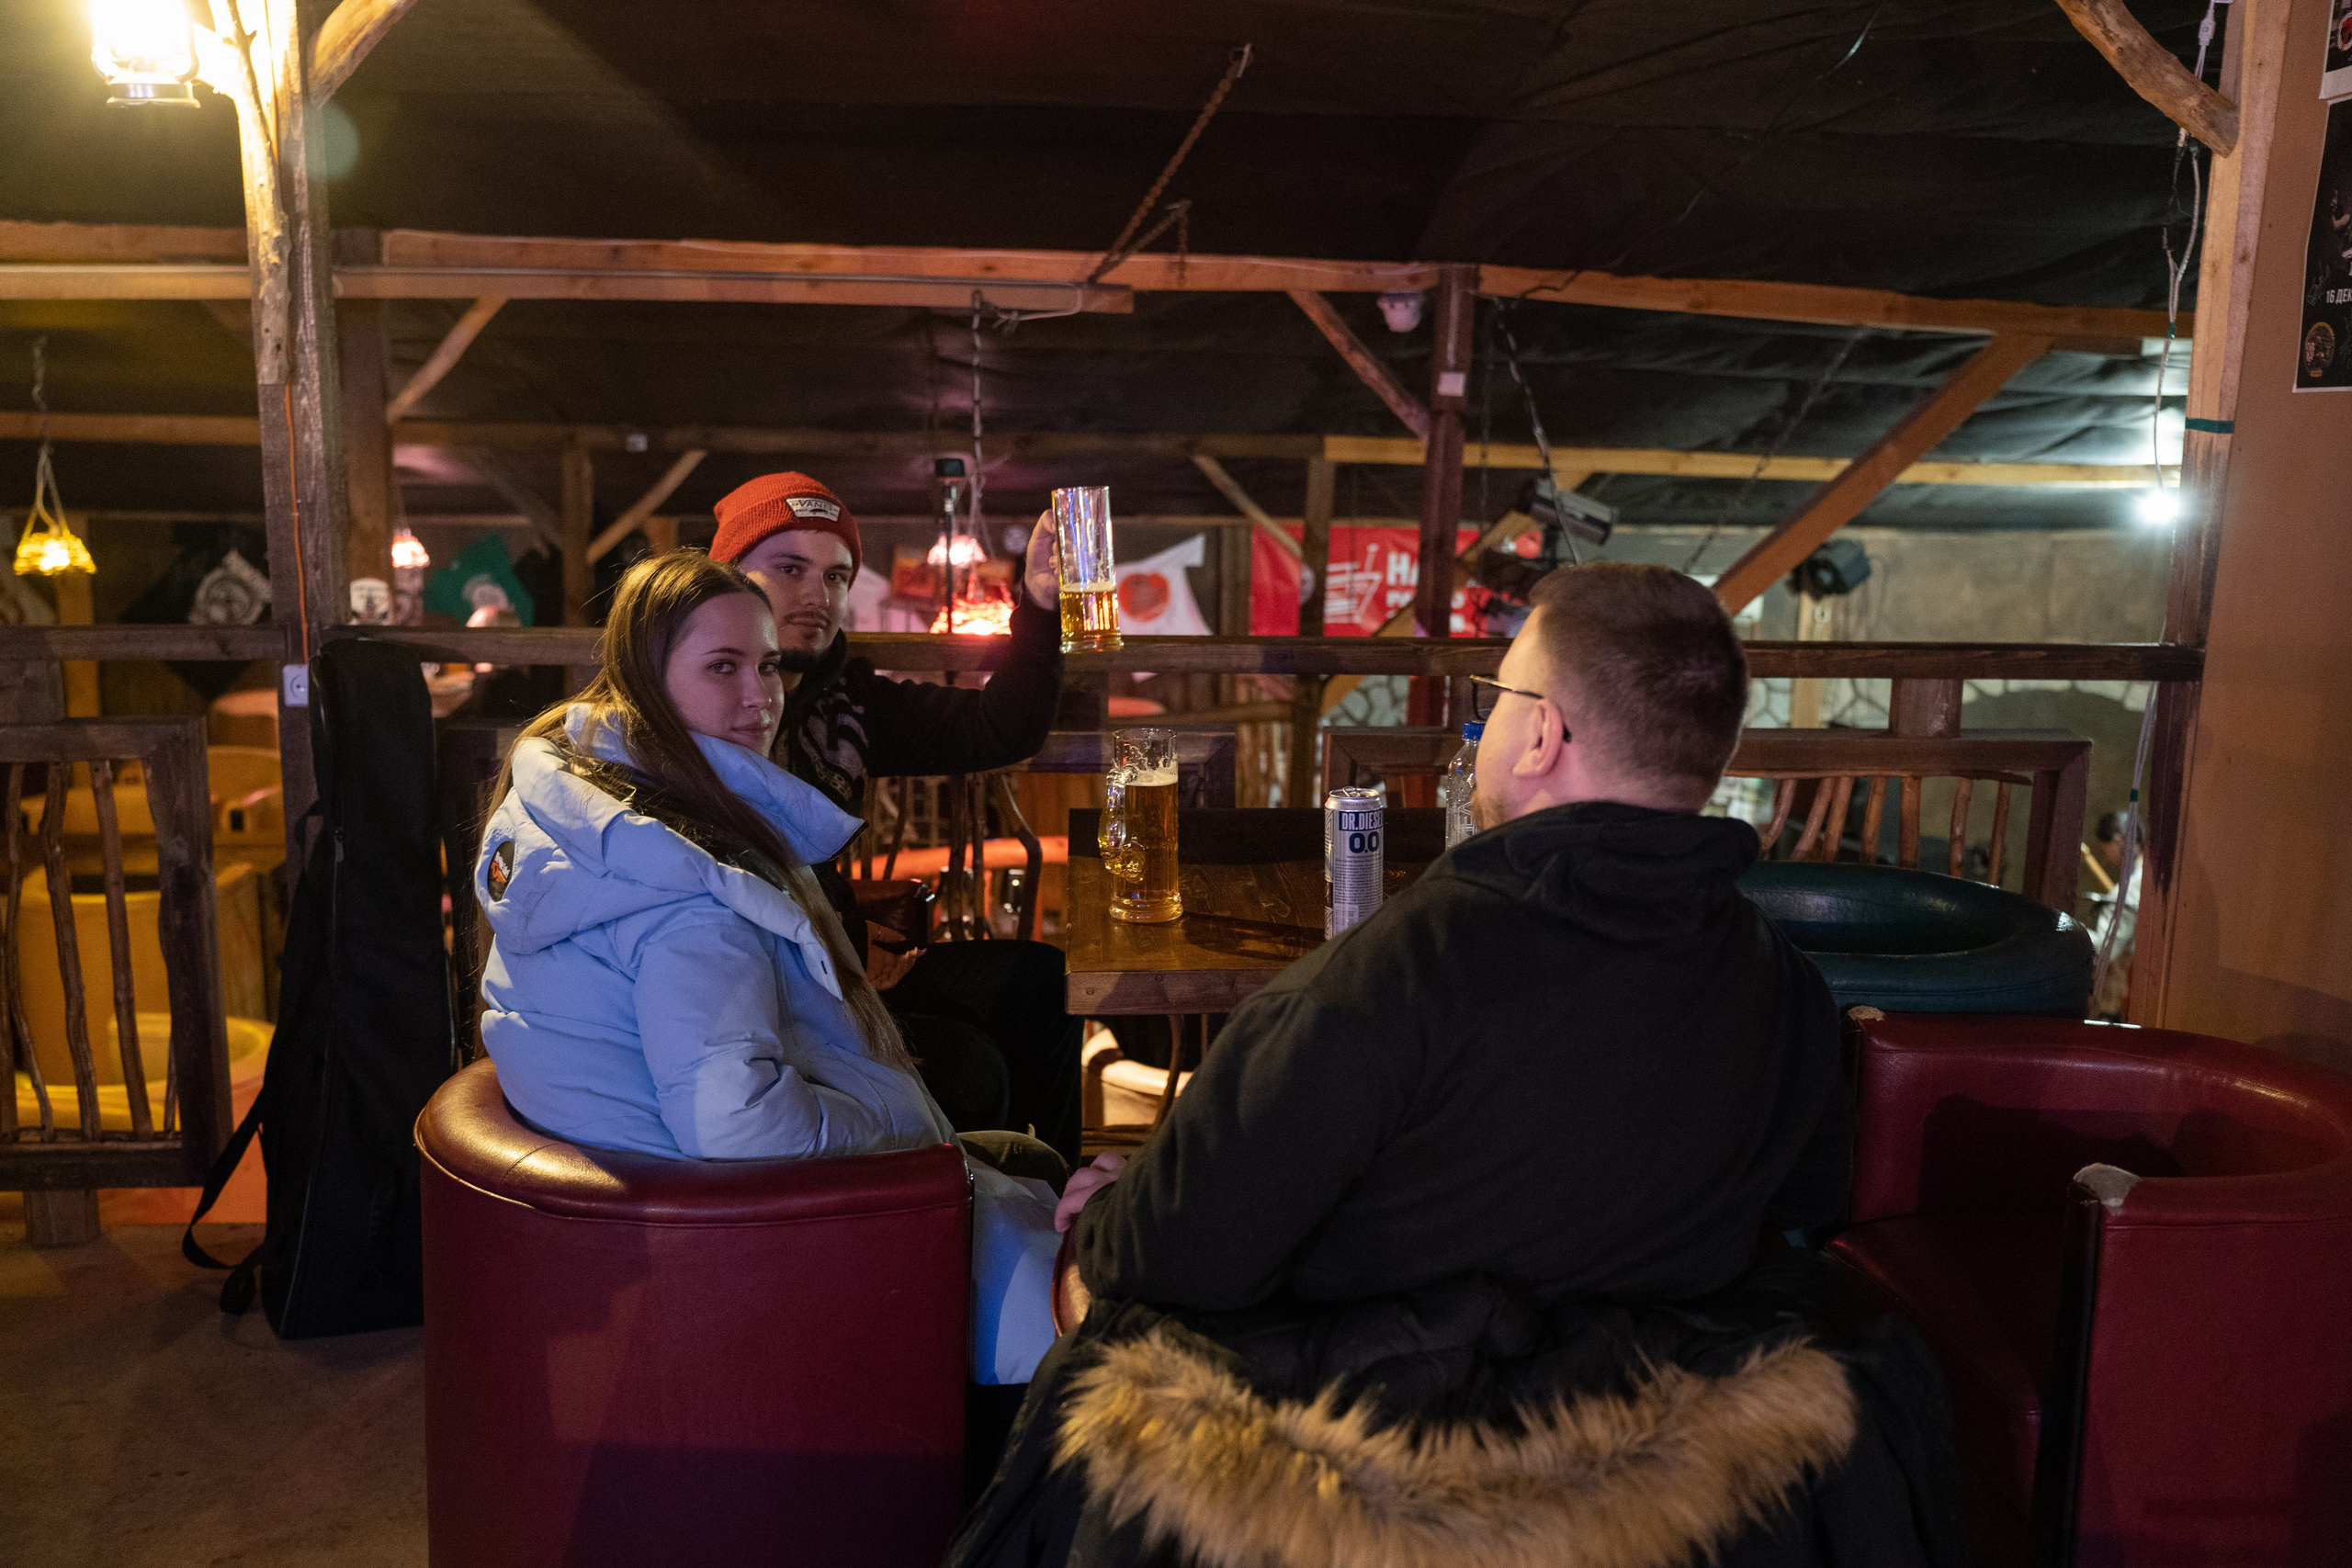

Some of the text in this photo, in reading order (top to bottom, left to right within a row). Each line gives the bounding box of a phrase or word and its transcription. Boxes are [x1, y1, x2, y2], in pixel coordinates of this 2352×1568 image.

[2325, 288, 2335, 303] 16
[798, 499, 832, 511] VANS
[1349, 831, 1379, 853] 0.0
